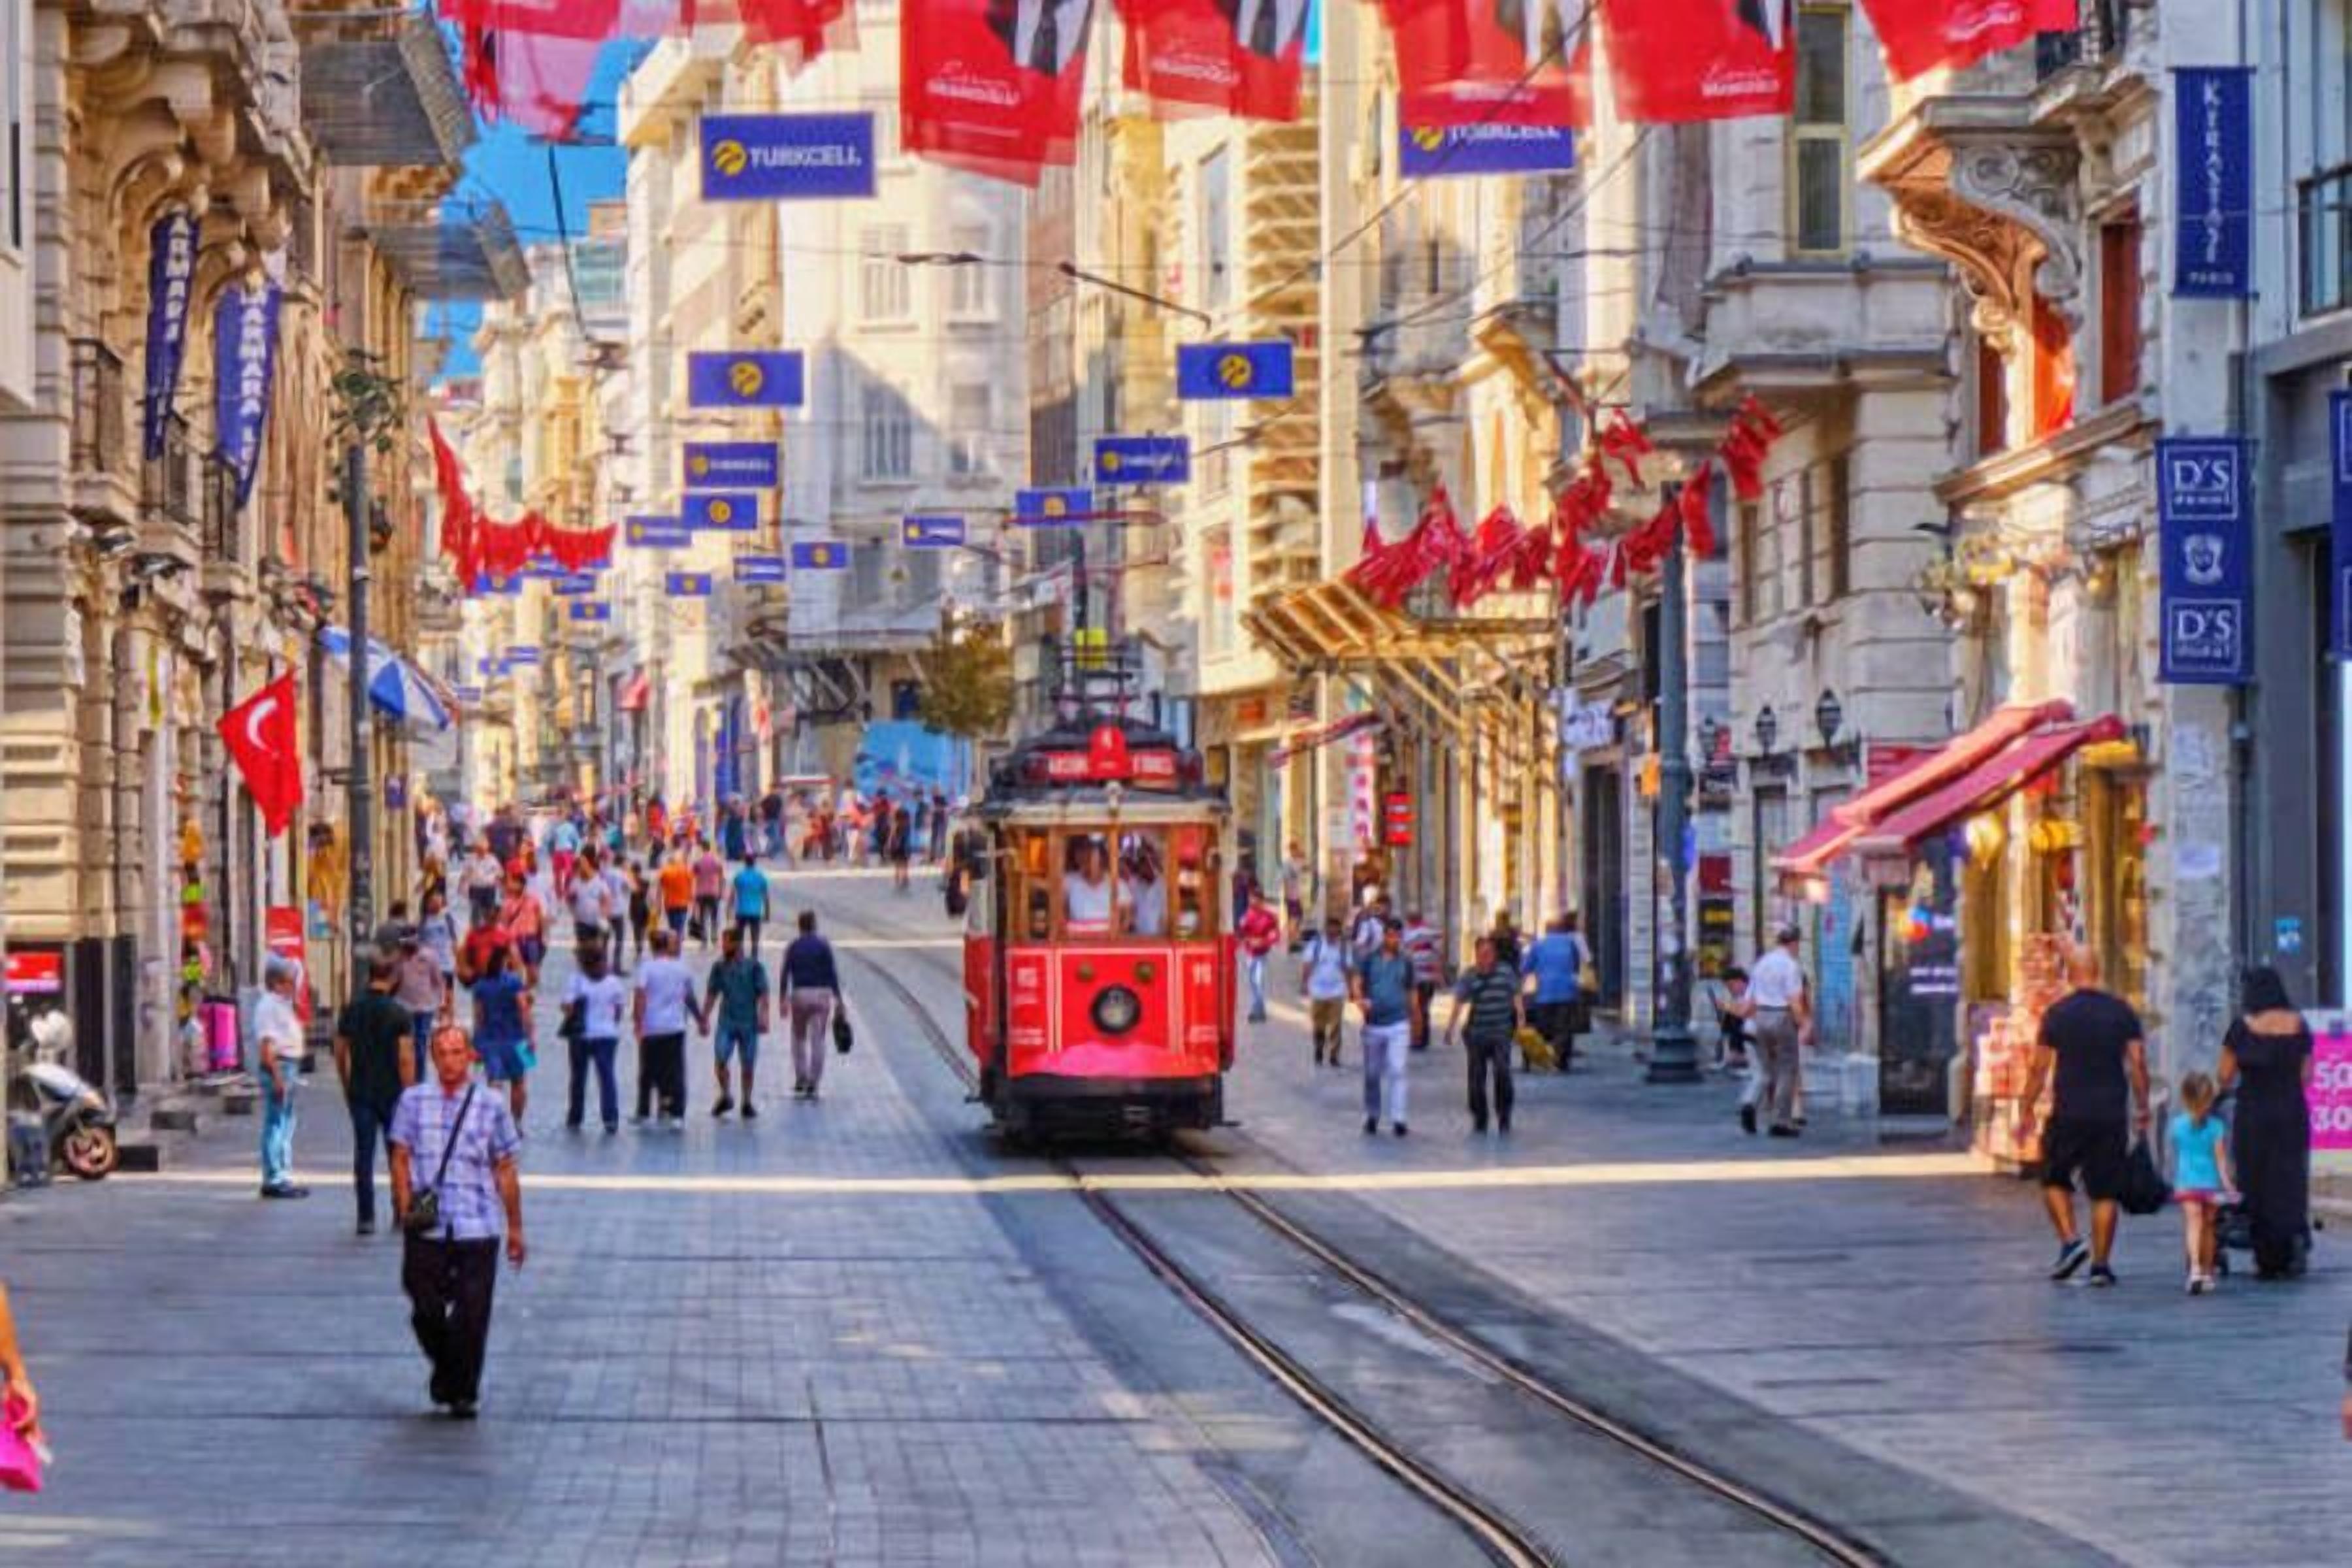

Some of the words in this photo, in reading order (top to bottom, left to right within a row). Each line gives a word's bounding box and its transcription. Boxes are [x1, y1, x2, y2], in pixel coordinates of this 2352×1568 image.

[750, 145, 862, 168] TURKCELL
[2174, 460, 2230, 491] D'S
[2178, 609, 2231, 640] D'S
